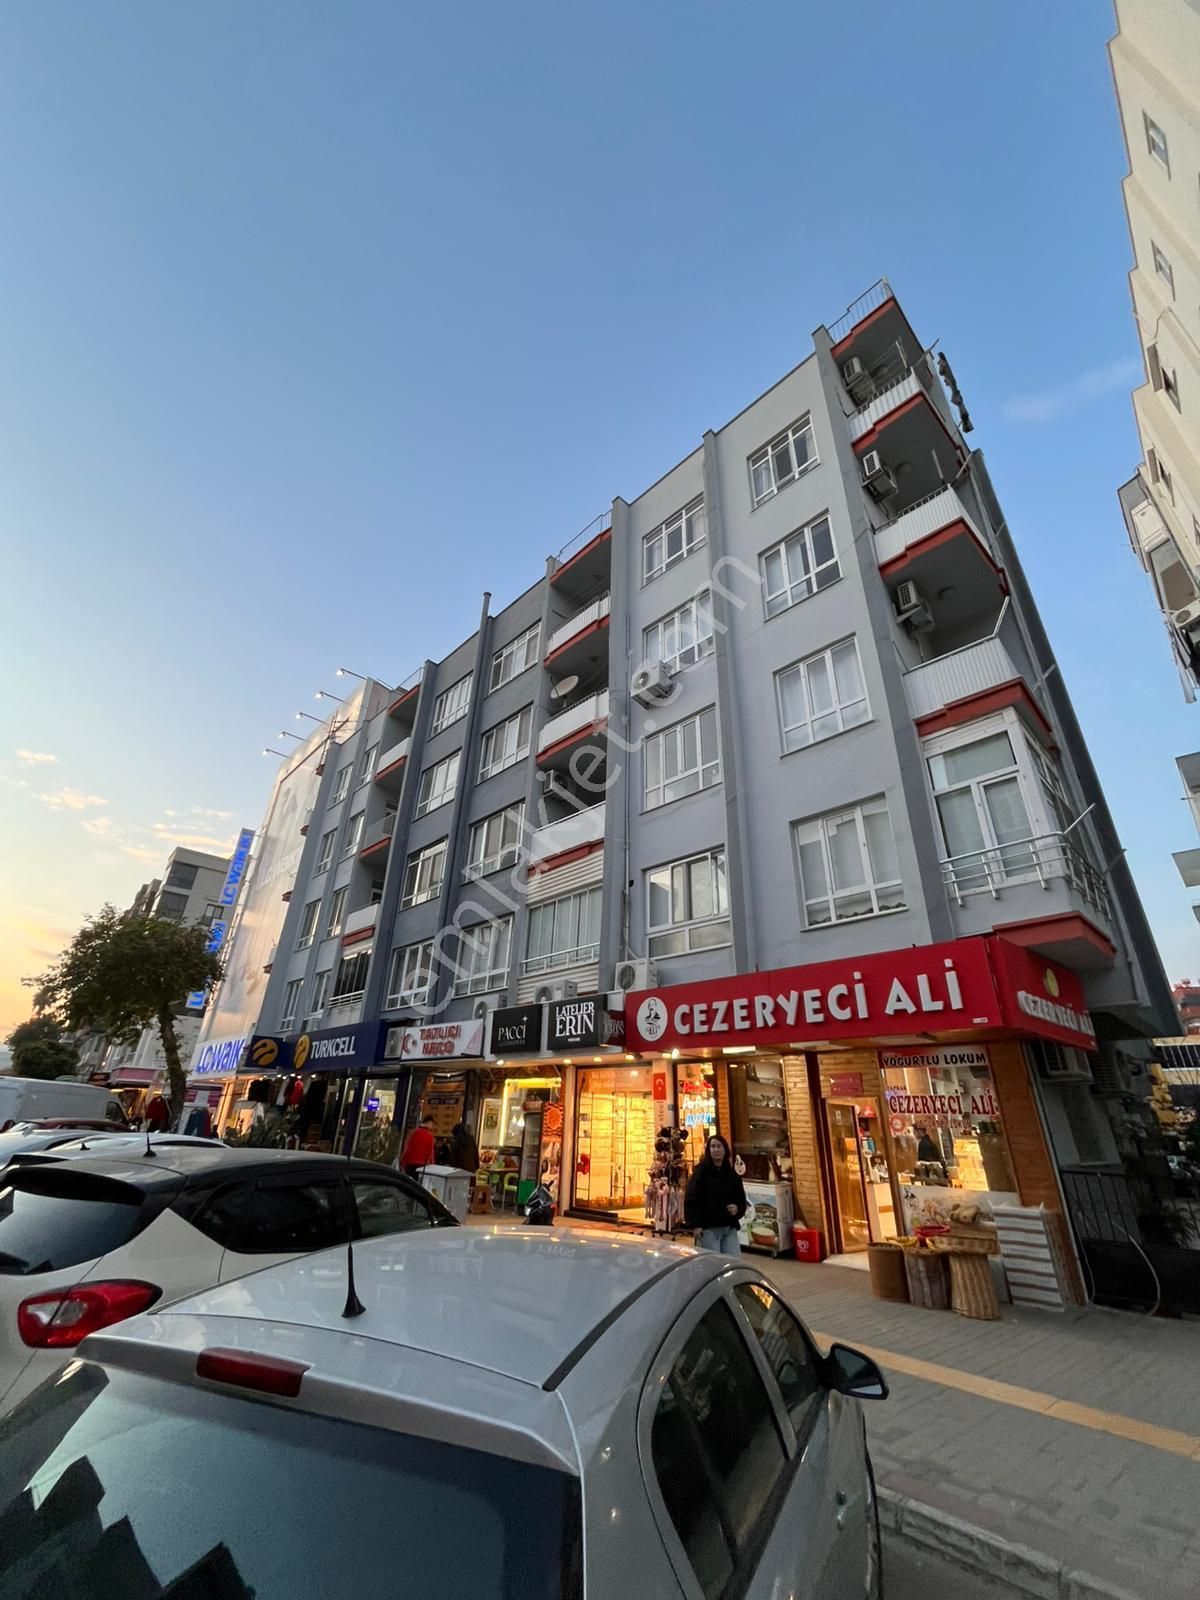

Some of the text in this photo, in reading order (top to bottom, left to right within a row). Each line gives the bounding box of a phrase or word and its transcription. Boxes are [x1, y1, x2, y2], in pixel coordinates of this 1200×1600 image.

[673, 958, 965, 1035] CEZERYECİ ALİ
[555, 1013, 595, 1037] ERIN
[310, 1036, 355, 1059] TURKCELL
[944, 1053, 986, 1065] LOKUM
[970, 1089, 996, 1115] ALİ
